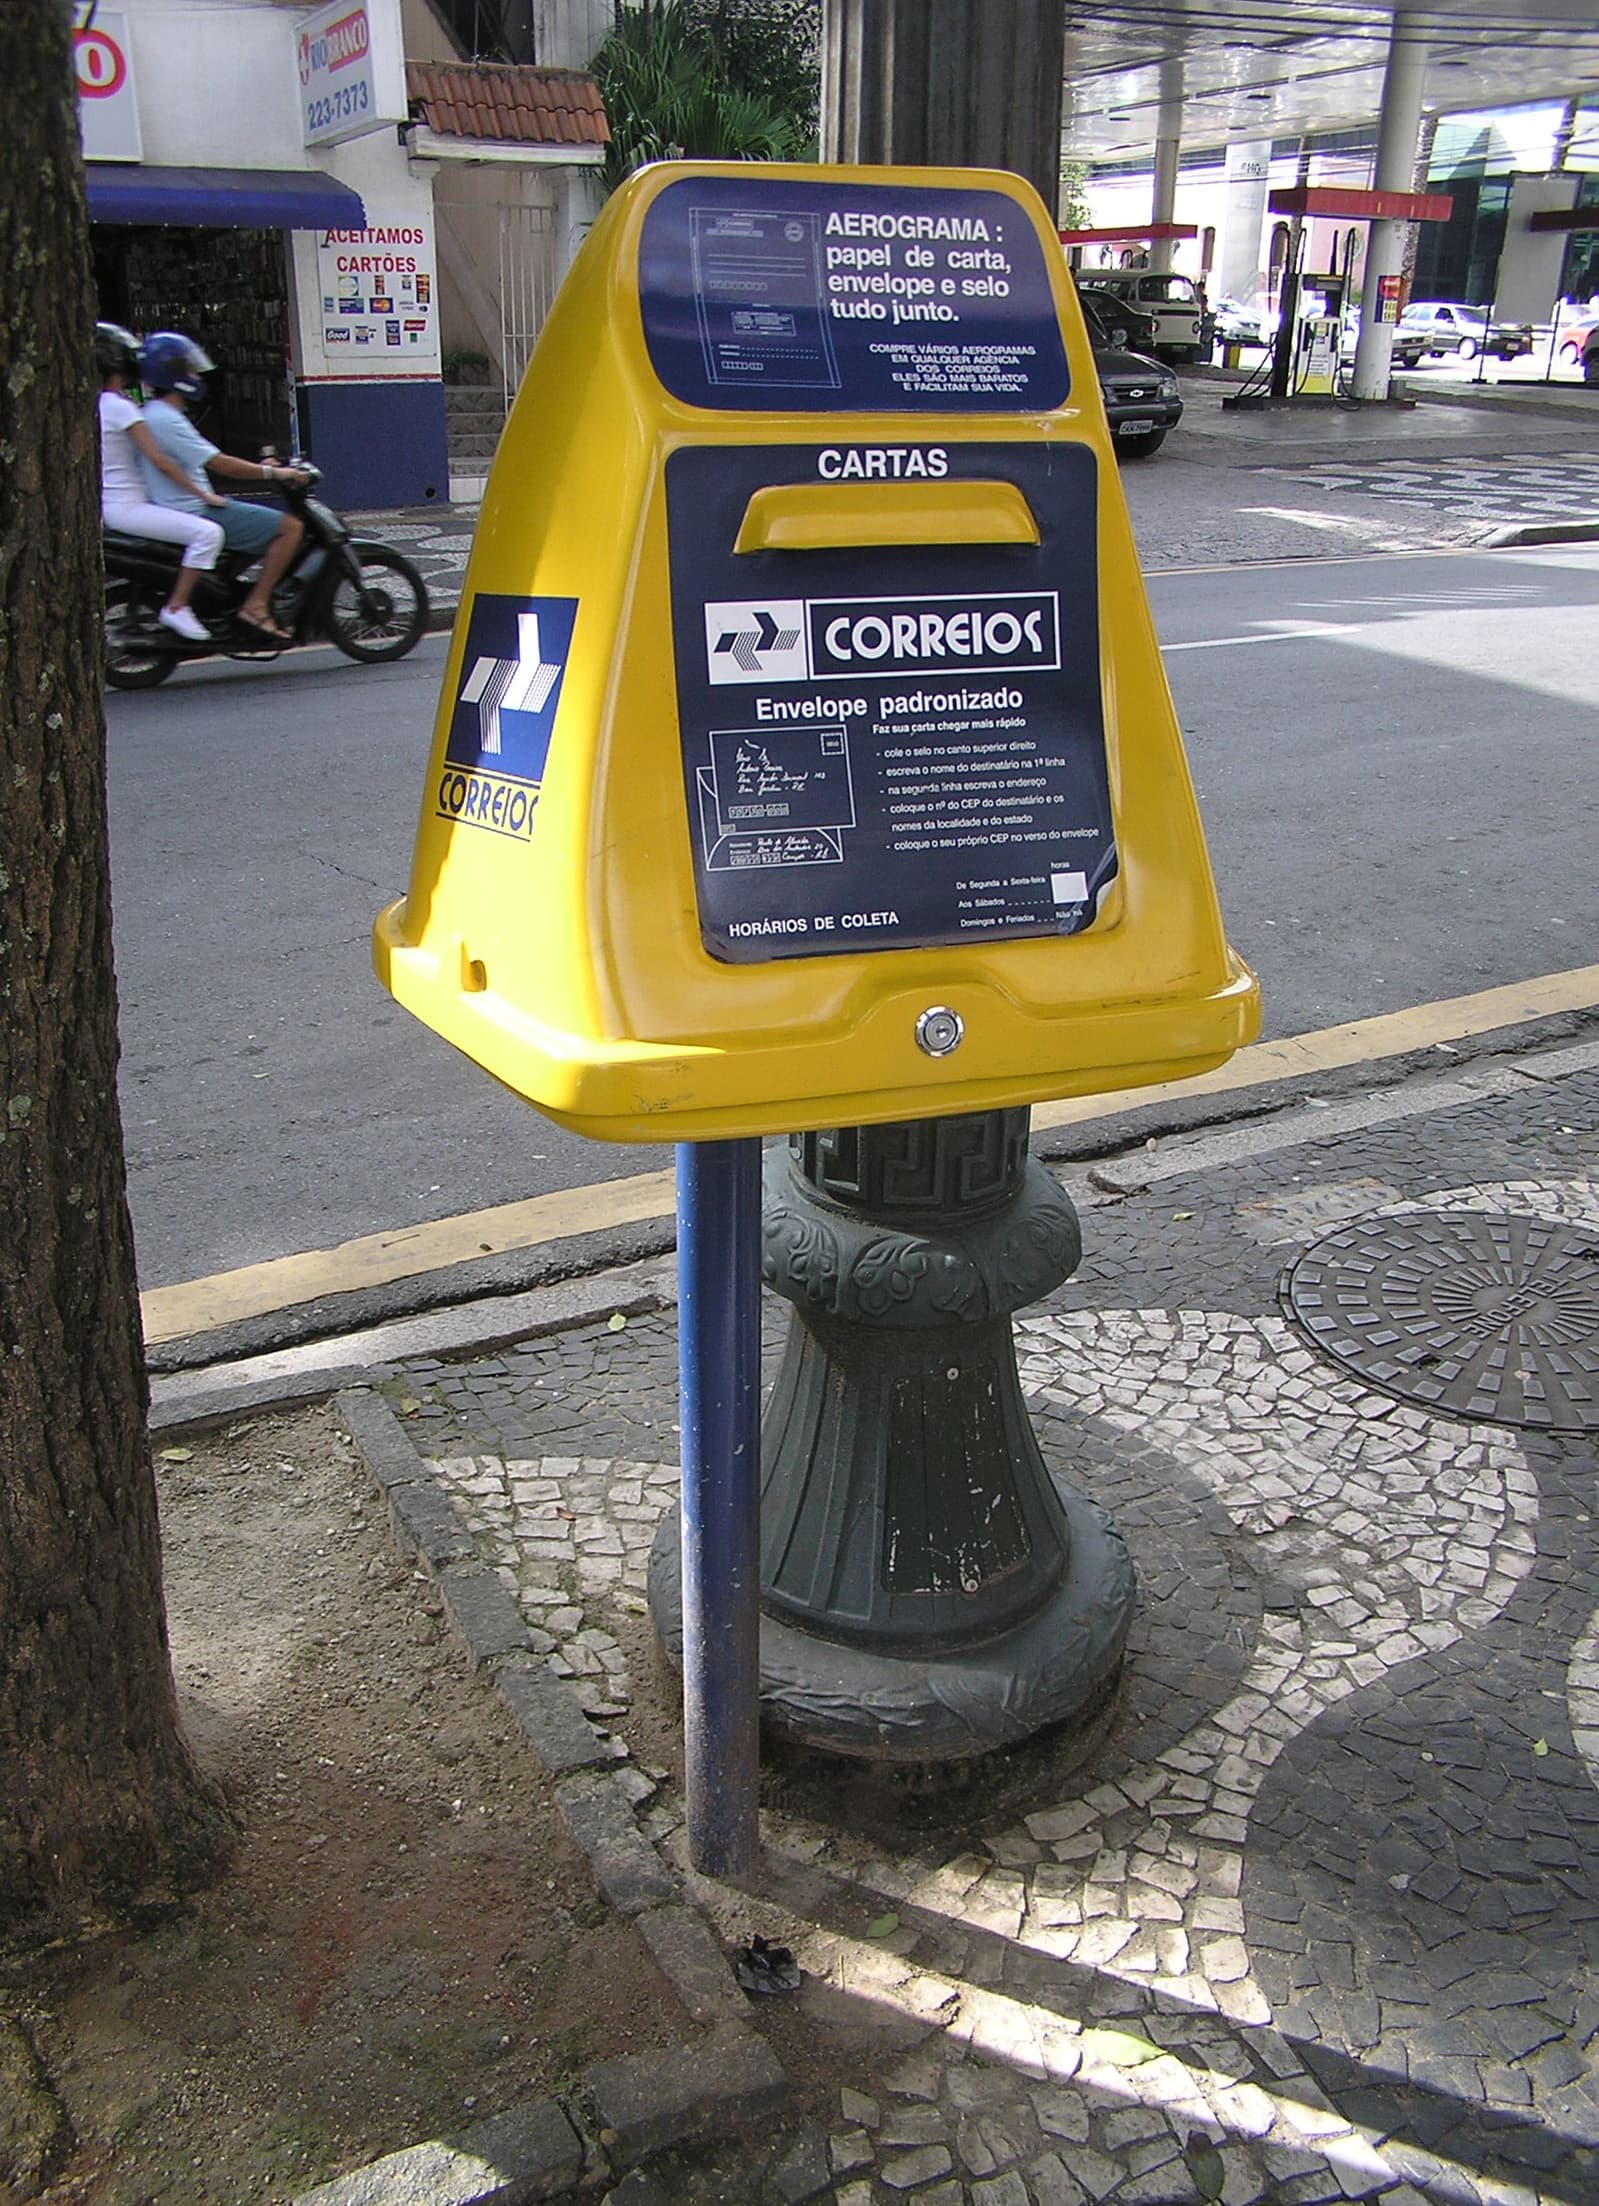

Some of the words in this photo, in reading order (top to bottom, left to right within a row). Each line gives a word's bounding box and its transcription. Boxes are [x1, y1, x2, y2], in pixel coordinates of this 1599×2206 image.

[326, 228, 423, 244] ACEITAMOS
[337, 253, 416, 272] CARTÕES
[827, 245, 890, 269] papel
[905, 247, 934, 267] de
[948, 249, 1011, 274] carta,
[828, 273, 935, 298] envelope
[941, 277, 955, 294] e
[961, 276, 1010, 296] selo
[831, 299, 886, 320] tudo
[892, 300, 959, 325] junto.
[869, 344, 917, 354] COMPRE
[918, 343, 958, 354] VÁRIOS
[962, 346, 1036, 355] AEROGRAMAS
[891, 355, 908, 363] EM
[911, 355, 970, 364] QUALQUER
[973, 355, 1019, 364] AGÊNCIA
[916, 365, 939, 373] DOS
[945, 365, 1000, 373] CORREIOS
[892, 373, 920, 381] ELES
[923, 373, 946, 382] SÃO
[950, 374, 976, 382] MAIS
[979, 374, 1028, 383] BARATOS
[903, 383, 911, 391] E
[915, 383, 968, 391] FACILITAM
[817, 448, 948, 479] CARTAS
[825, 610, 1042, 661] CORREIOS
[756, 695, 867, 720] Envelope
[880, 687, 1023, 719] padronizado
[873, 723, 889, 734] Faz
[892, 724, 909, 733] sua
[911, 722, 935, 733] carta
[938, 720, 969, 732] chegar
[972, 718, 994, 729] mais
[996, 718, 1026, 729] rápido
[884, 748, 903, 758] cole
[914, 746, 931, 756] selo
[947, 745, 971, 754] canto
[973, 742, 1007, 754] superior
[1009, 742, 1036, 751] direito
[886, 767, 920, 776] escreva
[930, 765, 955, 773] nome
[957, 762, 968, 772] do
[971, 760, 1019, 771] destinatário
[1021, 760, 1032, 768] na
[1045, 757, 1065, 767] linha
[888, 787, 900, 795] na
[902, 784, 939, 797] segunda
[941, 782, 962, 792] linha
[964, 781, 997, 790] escreva
[1006, 778, 1046, 789] endereço
[439, 773, 538, 836] CORREIOS
[890, 803, 925, 816] coloque
[948, 800, 959, 810] do
[961, 799, 980, 809] CEP
[982, 798, 994, 808] do
[996, 795, 1044, 807] destinatário
[1053, 795, 1064, 803] os
[892, 823, 922, 832] nomes
[924, 820, 935, 830] da
[937, 818, 981, 828] localidade
[990, 815, 1001, 825] do
[1004, 815, 1032, 824] estado
[894, 841, 930, 853] coloque
[940, 839, 955, 847] seu
[958, 836, 988, 848] próprio
[990, 834, 1009, 844] CEP
[1011, 834, 1022, 842] no
[1024, 832, 1047, 841] verso
[1049, 829, 1060, 839] do
[1062, 828, 1099, 840] envelope
[1051, 861, 1070, 869] horas
[969, 879, 999, 890] Segunda
[1011, 877, 1045, 885] Sexta-feira
[975, 898, 1005, 907] Sábados
[729, 915, 807, 937] HORÁRIOS
[814, 914, 835, 930] DE
[841, 911, 898, 929] COLETA
[961, 918, 995, 927] Domingos
[1006, 915, 1035, 923] Feriados
[1461, 1274, 1569, 1339] TELEFONE
